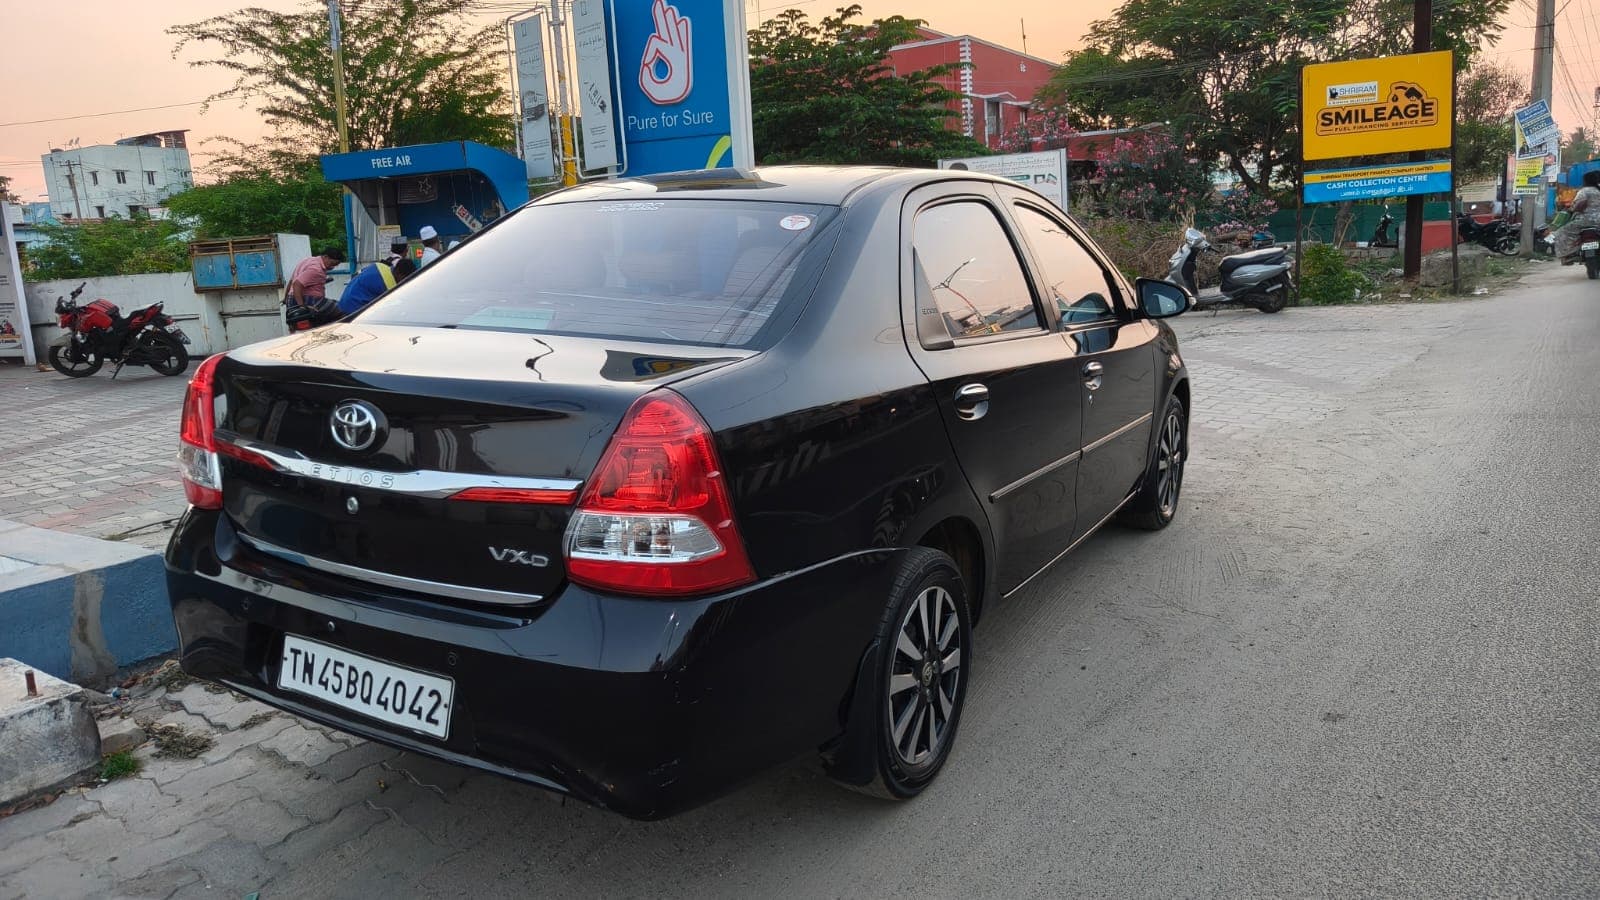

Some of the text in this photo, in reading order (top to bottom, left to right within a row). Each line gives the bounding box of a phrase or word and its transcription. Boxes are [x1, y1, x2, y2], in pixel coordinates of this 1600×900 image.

[1339, 84, 1377, 96] SHRIRAM
[628, 109, 714, 131] Pure for Sure
[1320, 102, 1434, 127] SMILEAGE
[1353, 122, 1389, 131] FINANCING
[1391, 119, 1419, 127] SERVICE
[371, 155, 412, 169] FREE AIR
[1326, 175, 1428, 190] CASH COLLECTION CENTRE
[313, 464, 395, 488] ETIOS
